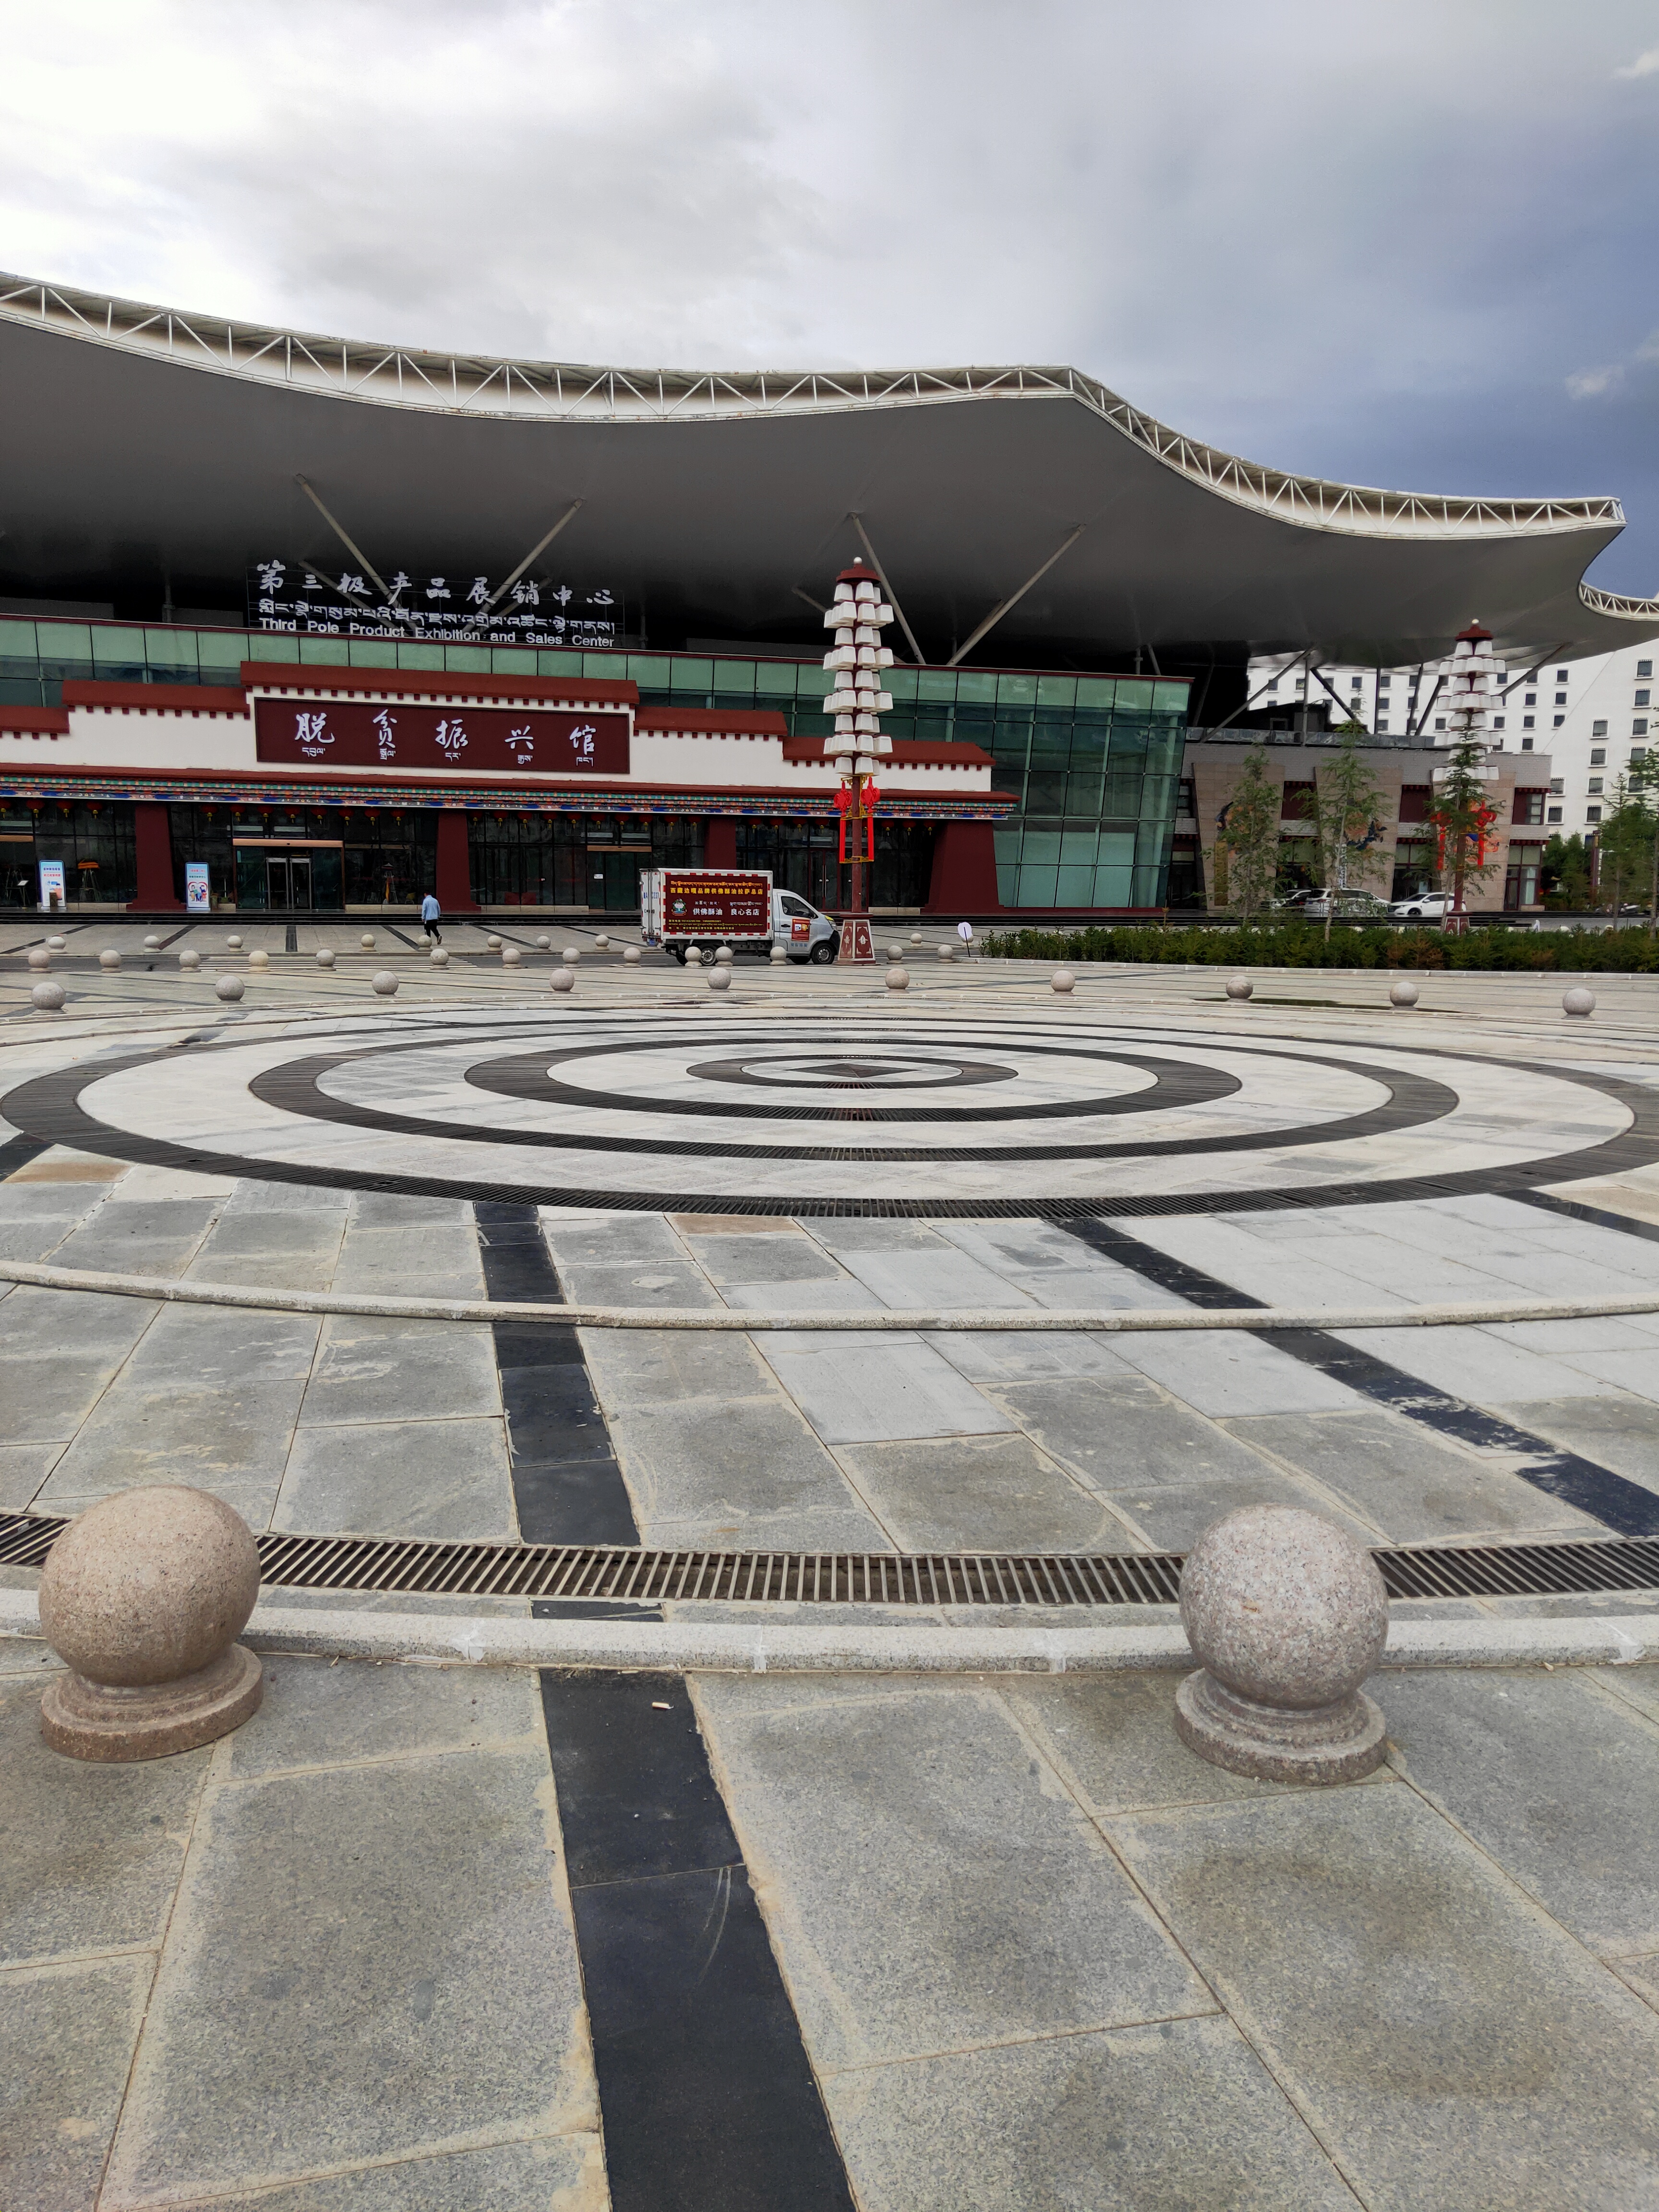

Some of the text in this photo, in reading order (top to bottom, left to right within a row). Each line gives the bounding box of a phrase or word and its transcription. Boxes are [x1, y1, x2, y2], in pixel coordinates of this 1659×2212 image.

[257, 560, 614, 606] 第三极产品展销中心
[259, 618, 614, 647] Third Pole Product Exhibition and Sales Center
[294, 709, 596, 756] 脱贫振兴馆
